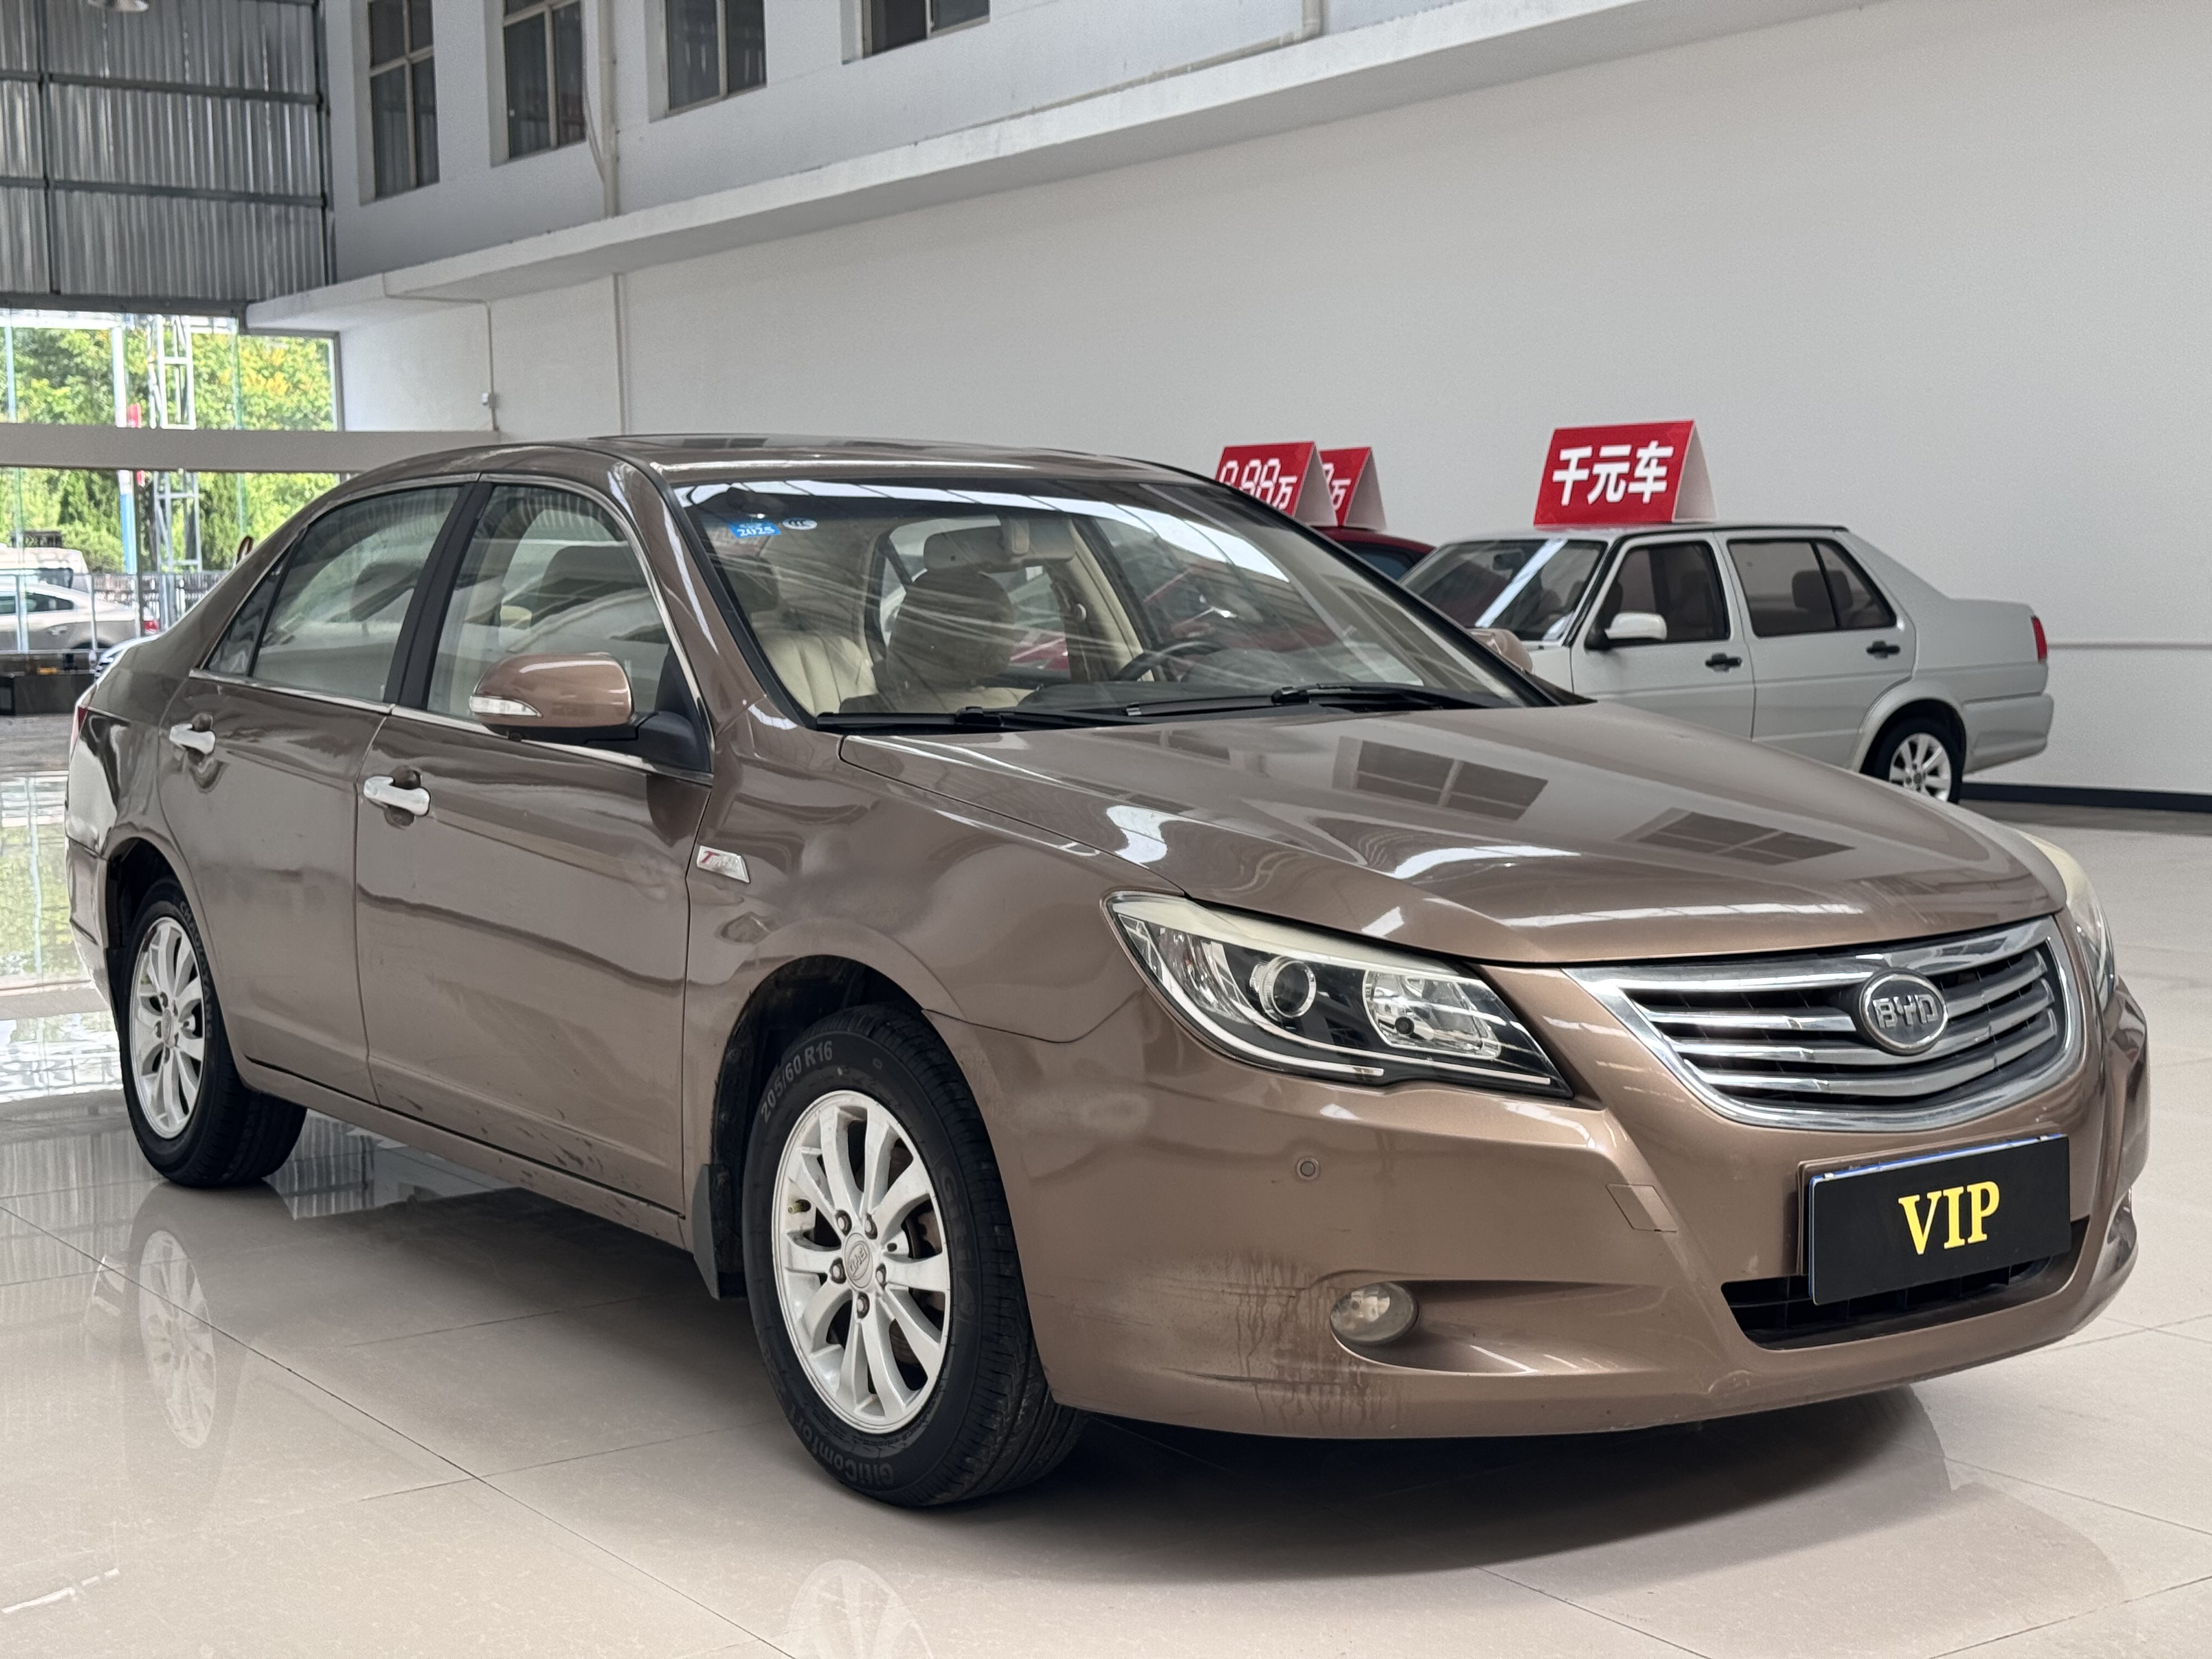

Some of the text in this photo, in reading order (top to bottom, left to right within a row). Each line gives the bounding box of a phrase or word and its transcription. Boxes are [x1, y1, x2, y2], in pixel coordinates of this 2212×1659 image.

[1553, 440, 1674, 506] 千元车
[1872, 993, 1938, 1029] BYD
[760, 1040, 833, 1123] 205/60 R16
[1898, 1181, 2000, 1255] VIP
